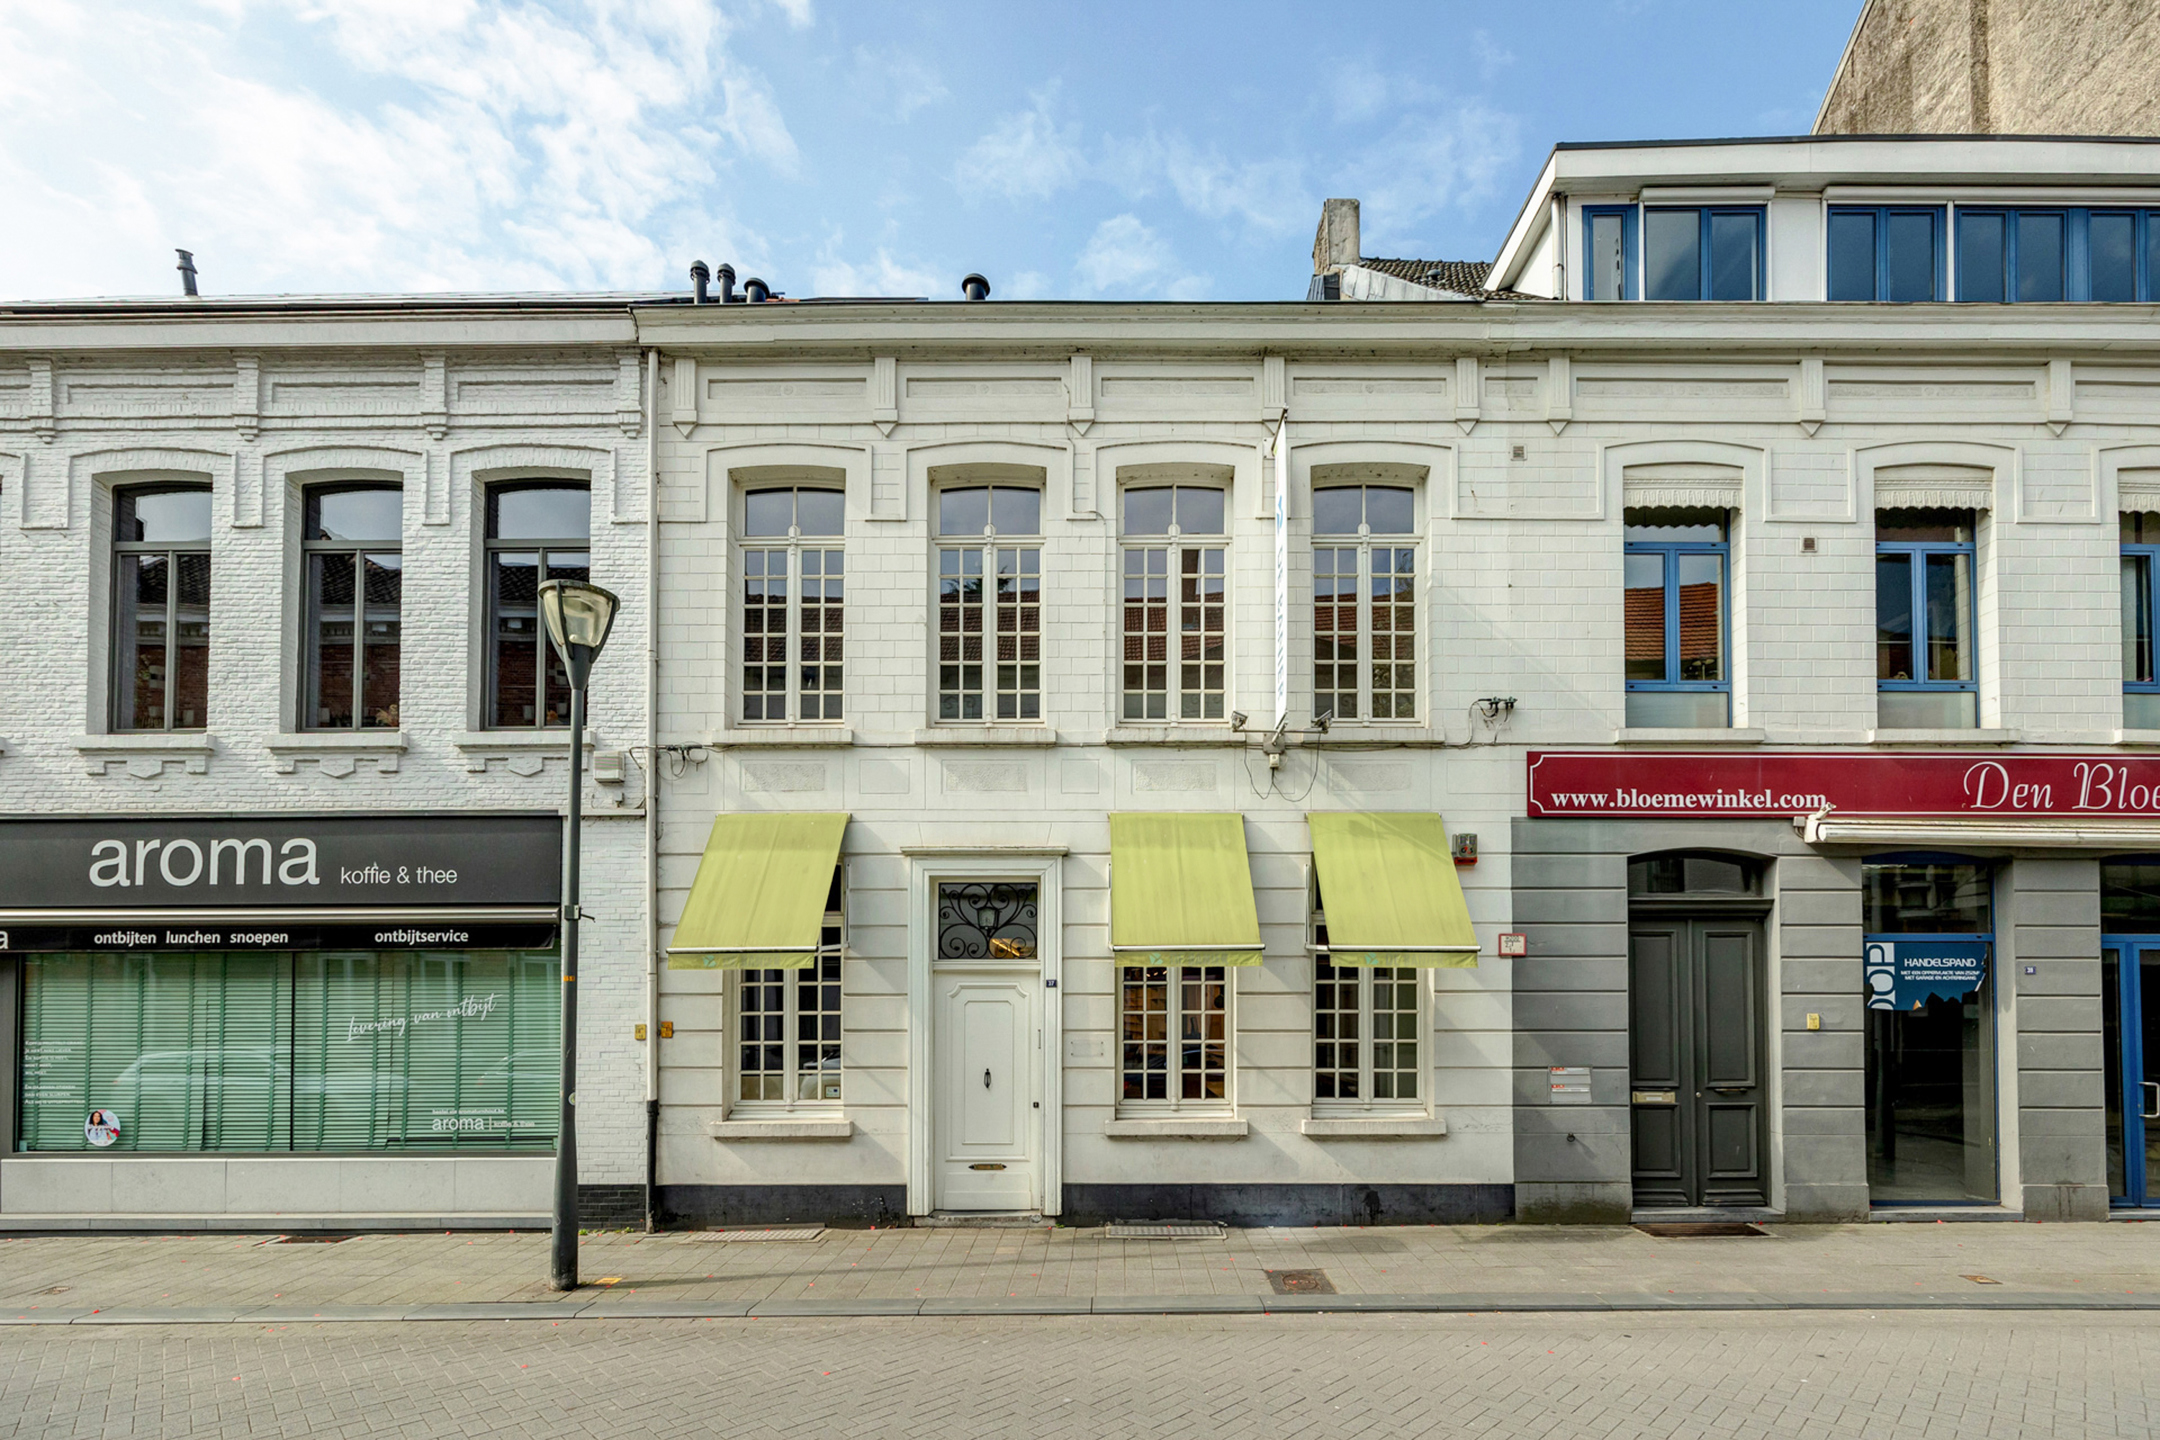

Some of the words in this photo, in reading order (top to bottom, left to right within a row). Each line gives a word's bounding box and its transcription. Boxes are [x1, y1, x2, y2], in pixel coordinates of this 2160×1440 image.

[1963, 761, 2054, 809] Den
[1551, 789, 1826, 808] www.bloemewinkel.com
[89, 838, 320, 887] aroma
[340, 864, 391, 884] koffie
[396, 866, 410, 884] &
[416, 866, 458, 884] thee
[94, 931, 156, 946] ontbijten
[166, 931, 221, 944] lunchen
[230, 932, 288, 945] snoepen
[374, 929, 469, 945] ontbijtservice
[1904, 958, 1976, 967] HANDELSPAND
[346, 1017, 408, 1042] Levering
[414, 1012, 442, 1024] van
[447, 993, 503, 1021] ontbijt
[432, 1118, 485, 1131] aroma
